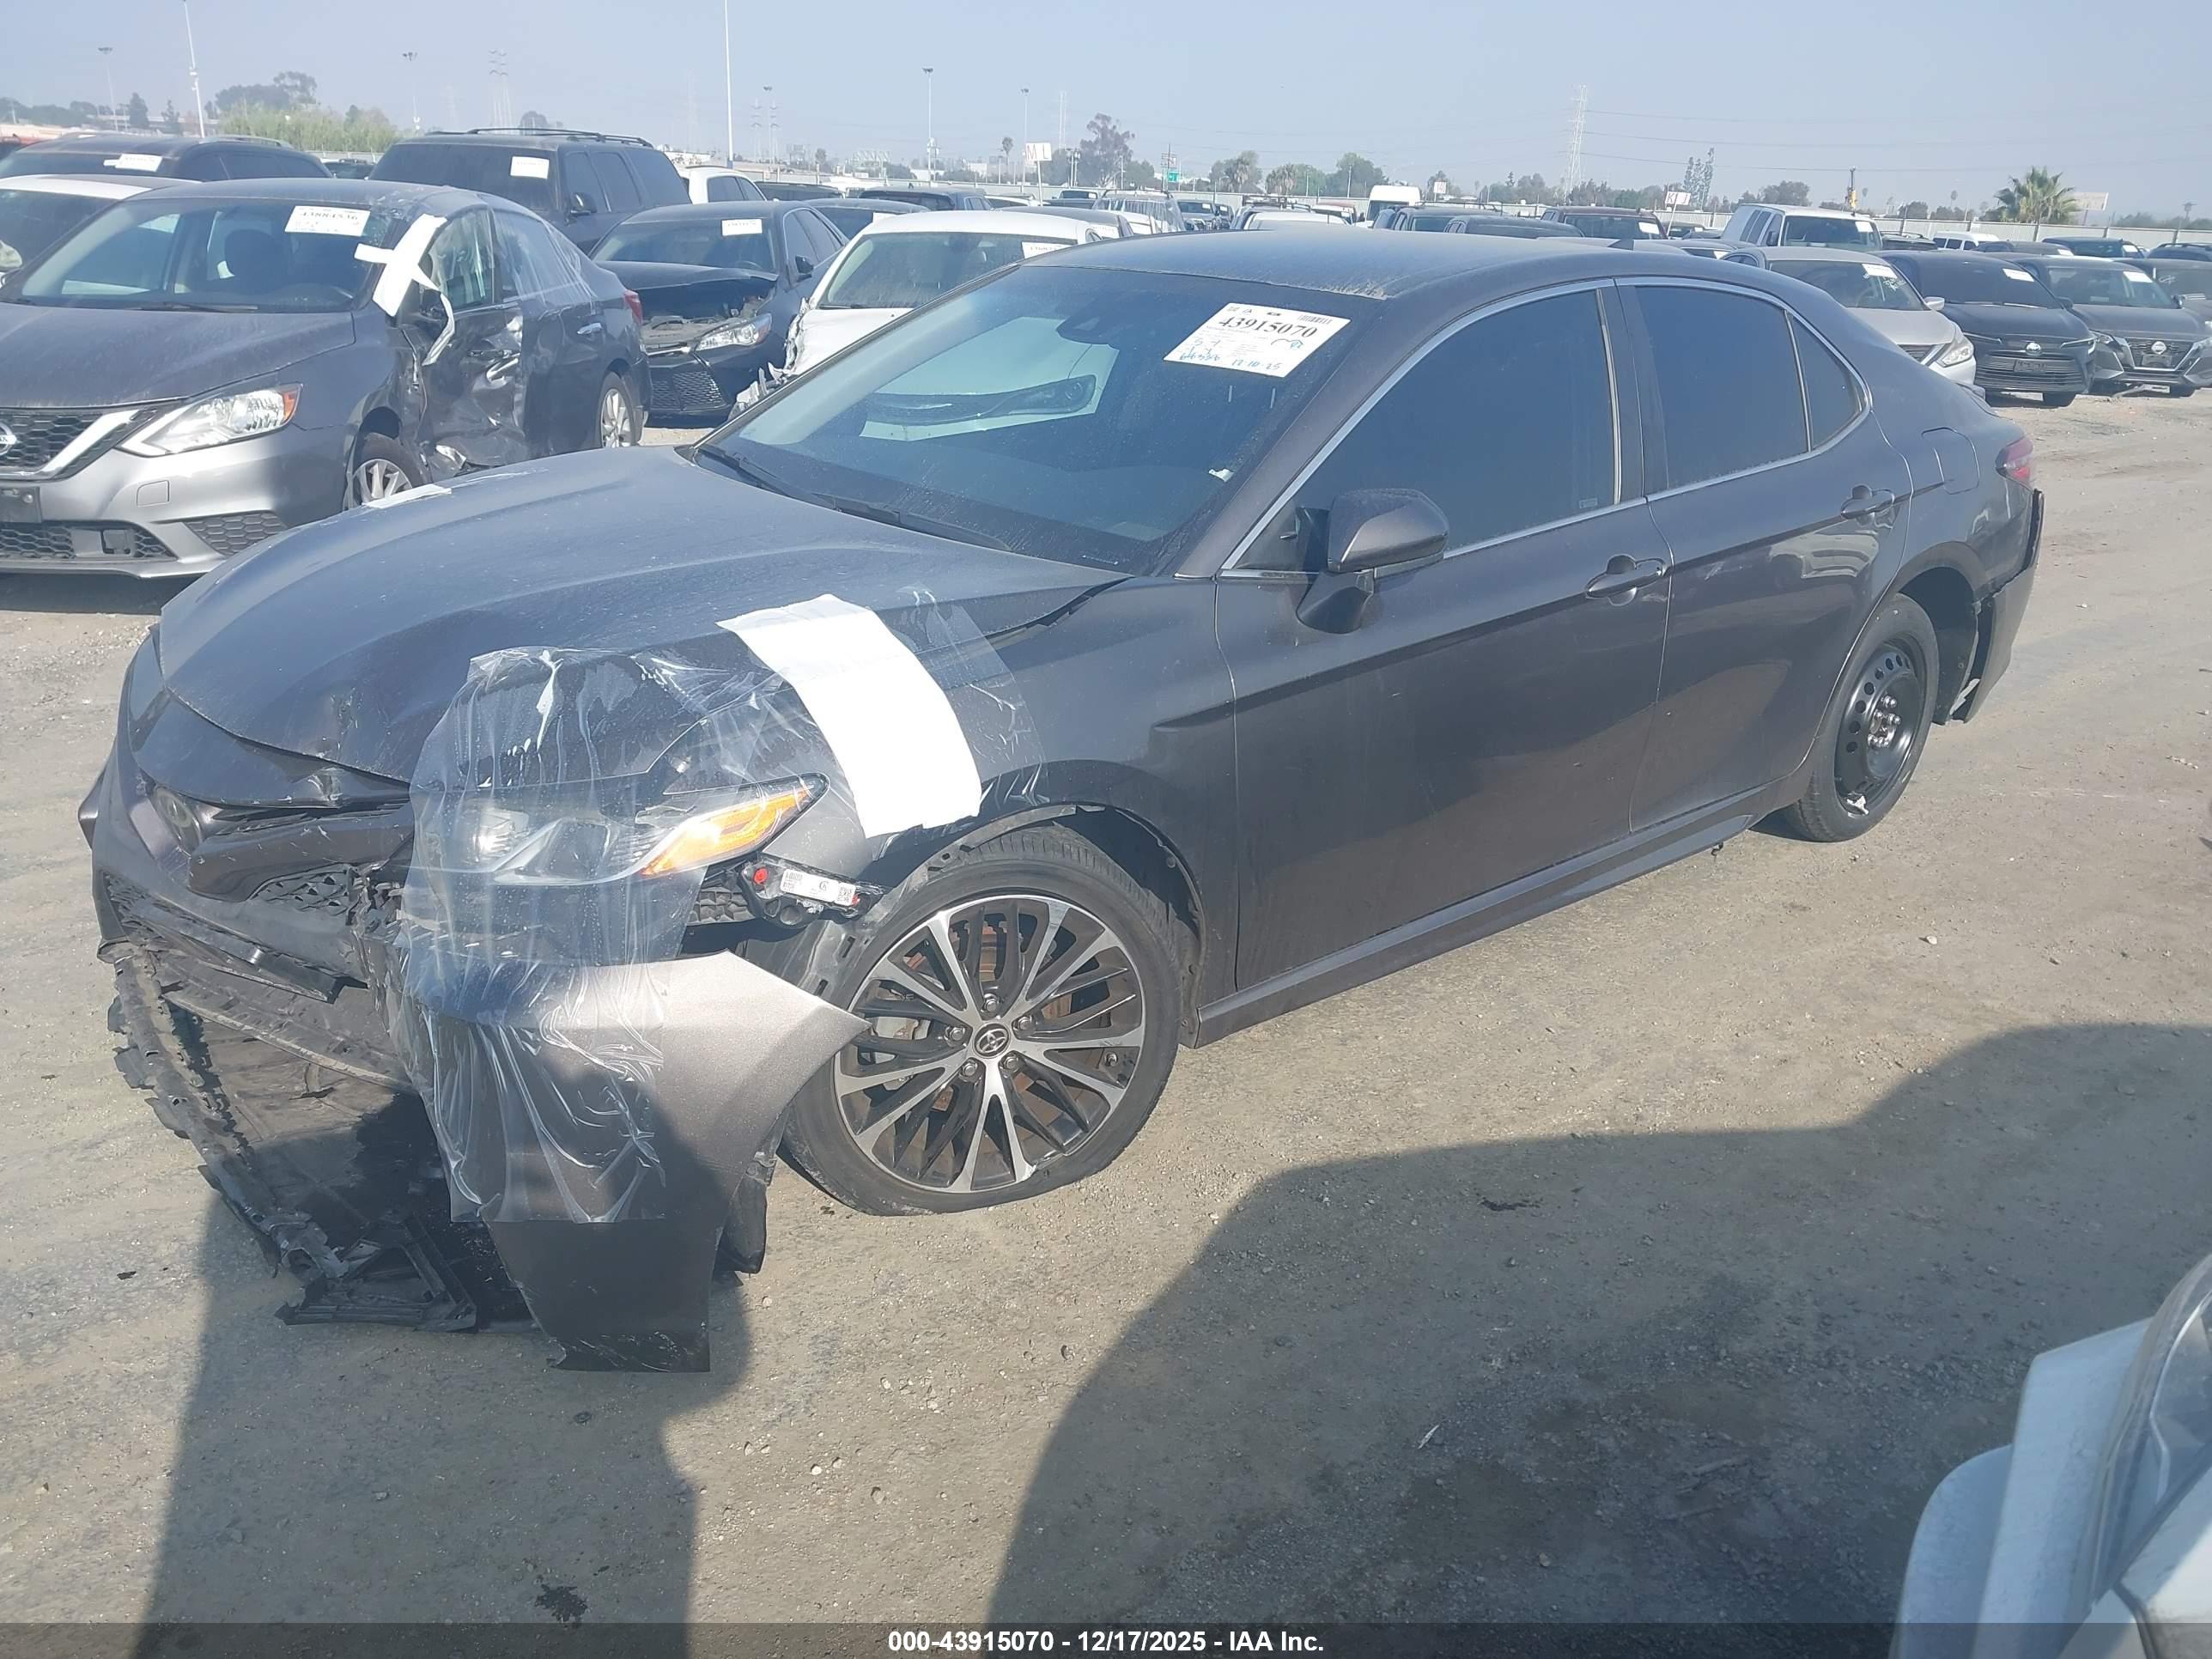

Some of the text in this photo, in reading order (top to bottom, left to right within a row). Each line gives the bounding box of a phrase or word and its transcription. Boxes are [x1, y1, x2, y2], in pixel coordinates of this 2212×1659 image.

[1027, 144, 1049, 160] M L
[1667, 192, 1675, 204] K
[1218, 316, 1318, 338] 43915070
